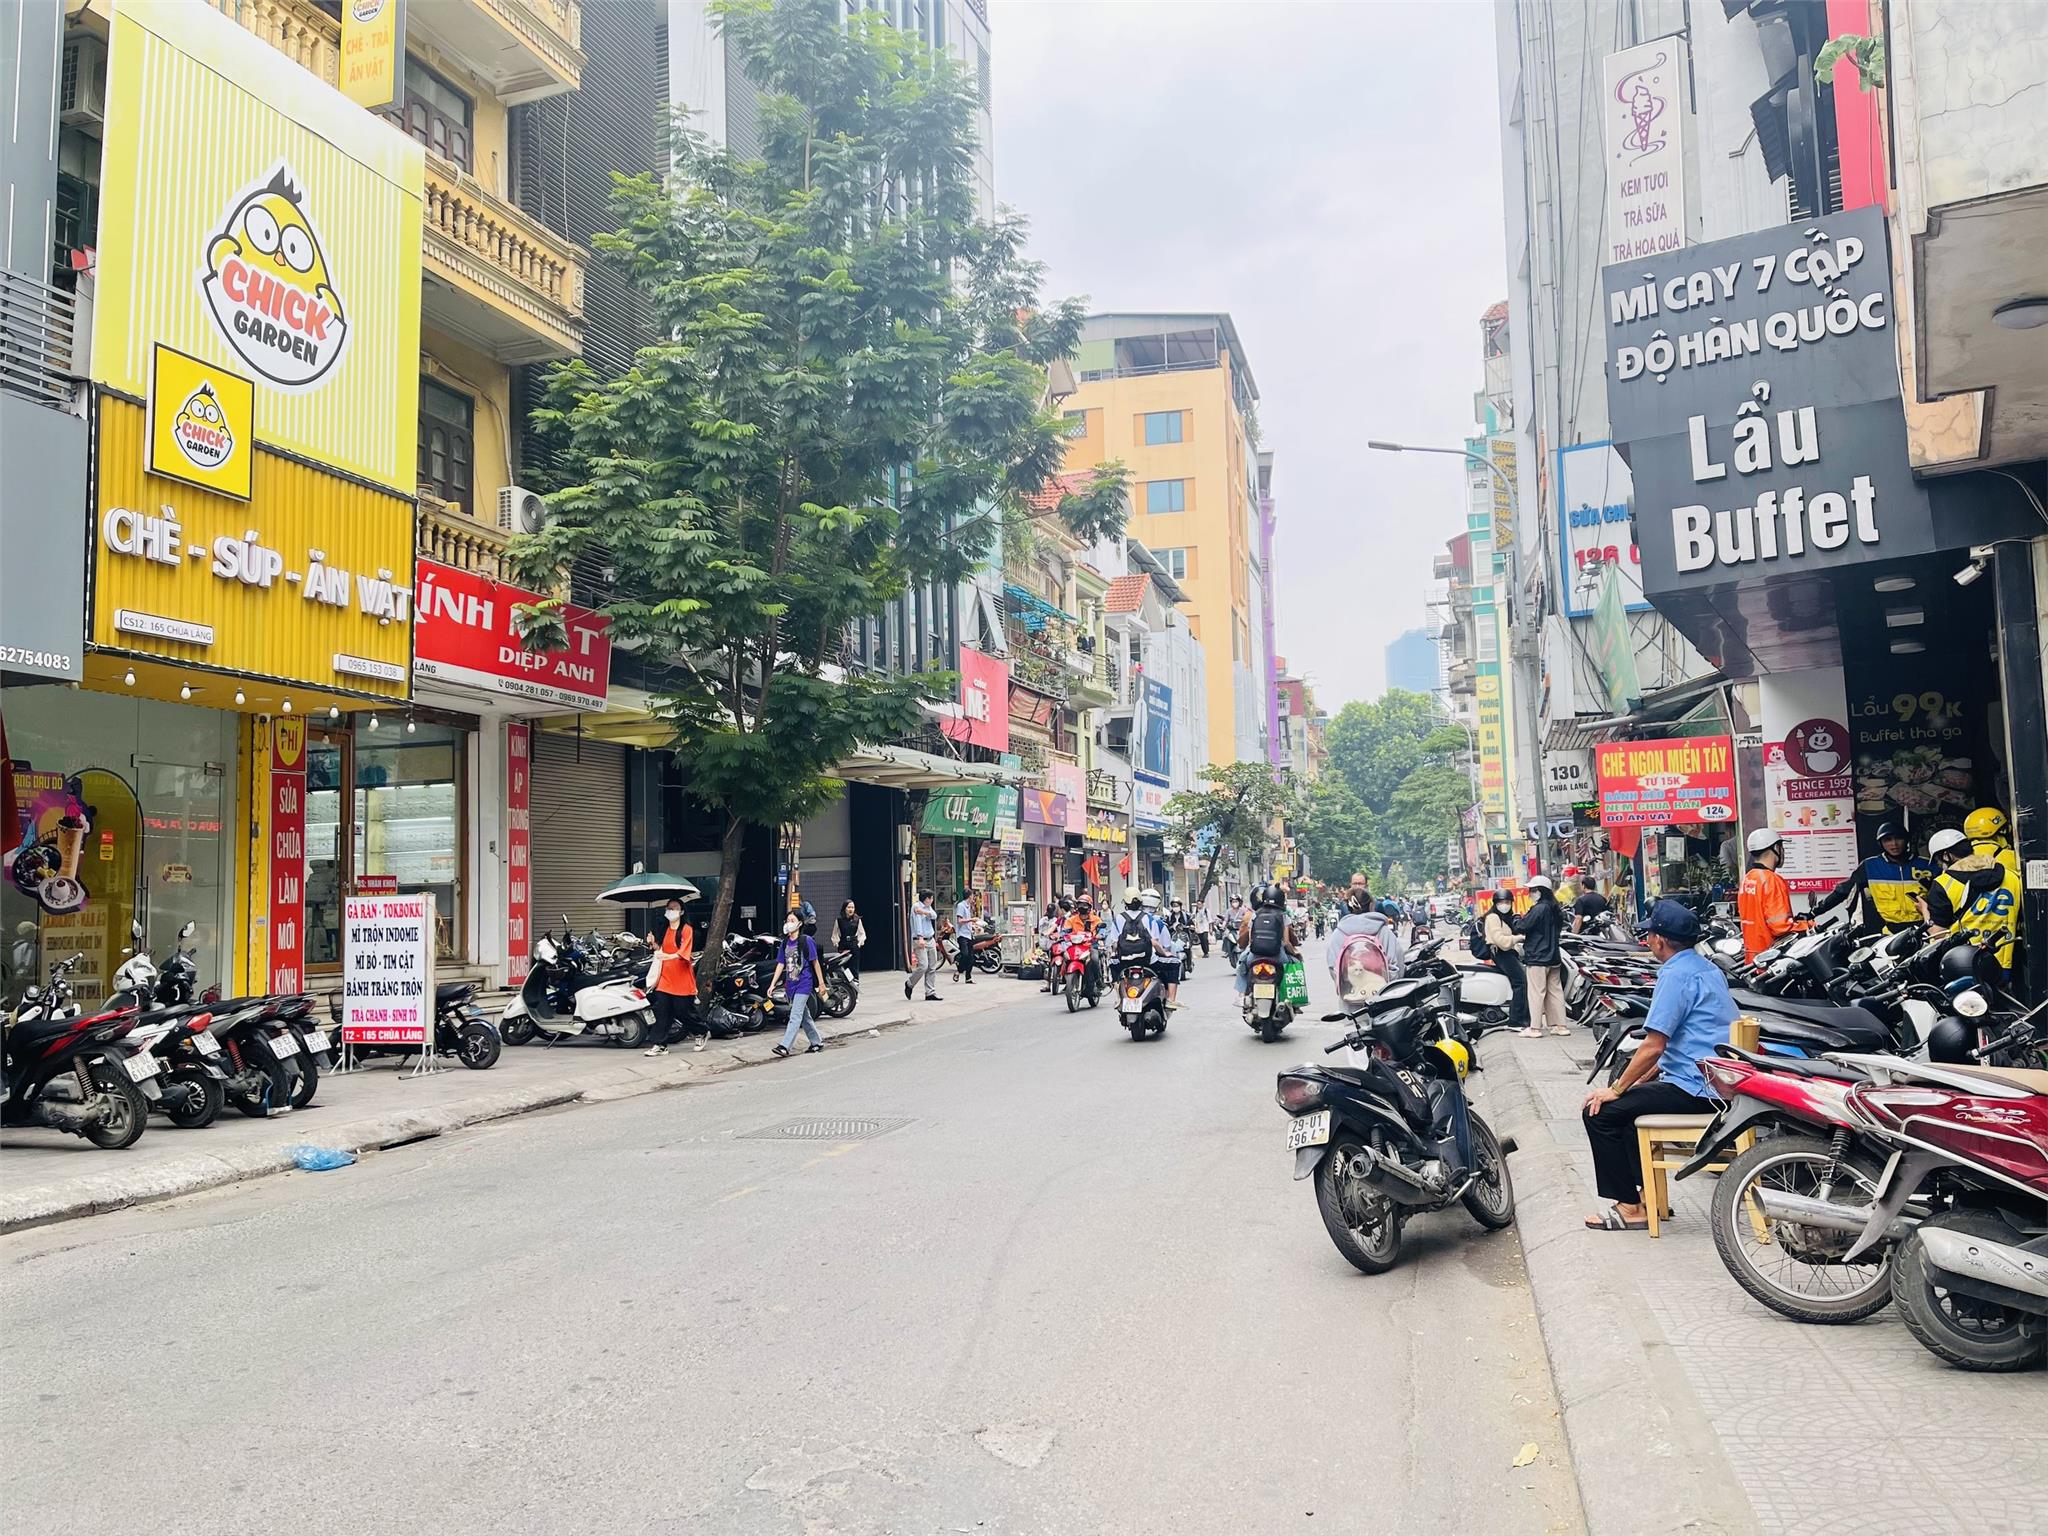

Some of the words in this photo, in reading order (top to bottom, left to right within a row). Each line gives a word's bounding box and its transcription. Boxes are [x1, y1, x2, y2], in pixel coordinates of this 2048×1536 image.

[1620, 178, 1641, 199] KEM
[1624, 205, 1643, 225] TRÀ
[1645, 203, 1667, 223] SỮA
[1613, 240, 1633, 261] TRÀ
[1635, 236, 1656, 257] HOA
[1657, 227, 1680, 252] QUẢ
[222, 259, 330, 342] CHICK
[1610, 273, 1660, 325] MÌ
[1663, 261, 1741, 312] CAY
[1753, 254, 1777, 293] 7
[233, 309, 319, 366] GARDEN
[1615, 331, 1676, 383] ĐỘ
[1679, 315, 1761, 368] HÀN
[1765, 286, 1886, 352] QUỐC
[181, 420, 225, 449] CHICK
[1688, 380, 1821, 483] Lẩu
[186, 439, 220, 460] GARDEN
[1569, 503, 1601, 529] SỬA
[1671, 475, 1881, 573] Buffet
[102, 504, 181, 566] CHÈ
[212, 530, 283, 588] SÚP
[303, 548, 350, 608] ĂN
[356, 567, 413, 626] VẶT
[415, 572, 494, 630] ÍNH
[151, 622, 165, 632] 165
[369, 663, 382, 675] 153
[499, 646, 548, 673] DIỆP
[554, 660, 595, 683] ANH
[1851, 695, 1889, 717] Lẩu
[511, 731, 527, 758] KÍNH
[1860, 728, 1905, 743] Buffet
[1942, 727, 1962, 740] ga
[1602, 747, 1627, 778] CHÈ
[1629, 750, 1664, 777] NGON
[1666, 740, 1701, 774] MIỀN
[1703, 742, 1727, 773] TÂY
[513, 767, 523, 793] ÁP
[1550, 764, 1580, 781] 130
[1660, 776, 1681, 786] 15K
[1790, 780, 1826, 791] SINCE
[1829, 777, 1852, 789] 1997
[279, 779, 298, 814] SỬA
[944, 788, 972, 822] CHÈ
[1604, 789, 1638, 802] BÁNH
[1604, 801, 1634, 813] NEM
[1637, 800, 1670, 811] CHUA
[1673, 799, 1702, 810] RÁN
[1791, 792, 1802, 800] ICE
[1706, 806, 1724, 815] 124
[276, 827, 301, 859] CHỮA
[511, 841, 527, 867] KÍNH
[278, 871, 298, 905] LÀM
[511, 877, 526, 903] MÀU
[1797, 880, 1823, 888] MIXUE
[347, 900, 359, 919] GÀ
[361, 900, 378, 919] RÁN
[383, 902, 424, 919] TOKBOKKI
[277, 917, 295, 950] MỚI
[351, 923, 361, 943] MÌ
[362, 923, 384, 947] TRỘN
[385, 927, 419, 943] INDOMIE
[355, 950, 365, 970] MÌ
[366, 950, 377, 970] BÒ
[383, 954, 397, 970] TIM
[398, 950, 414, 973] CẬT
[274, 963, 297, 995] KÍNH
[346, 977, 369, 997] BÁNH
[371, 977, 399, 997] TRÁNG
[401, 976, 423, 1001] TRỘN
[351, 1005, 364, 1022] TRÀ
[365, 1009, 388, 1022] CHANH
[392, 1009, 408, 1022] SINH
[409, 1003, 418, 1022] TỐ
[344, 1030, 355, 1040] T2
[362, 1029, 377, 1040] 165
[378, 1028, 400, 1040] CHÙA
[401, 1028, 423, 1040] LÁNG
